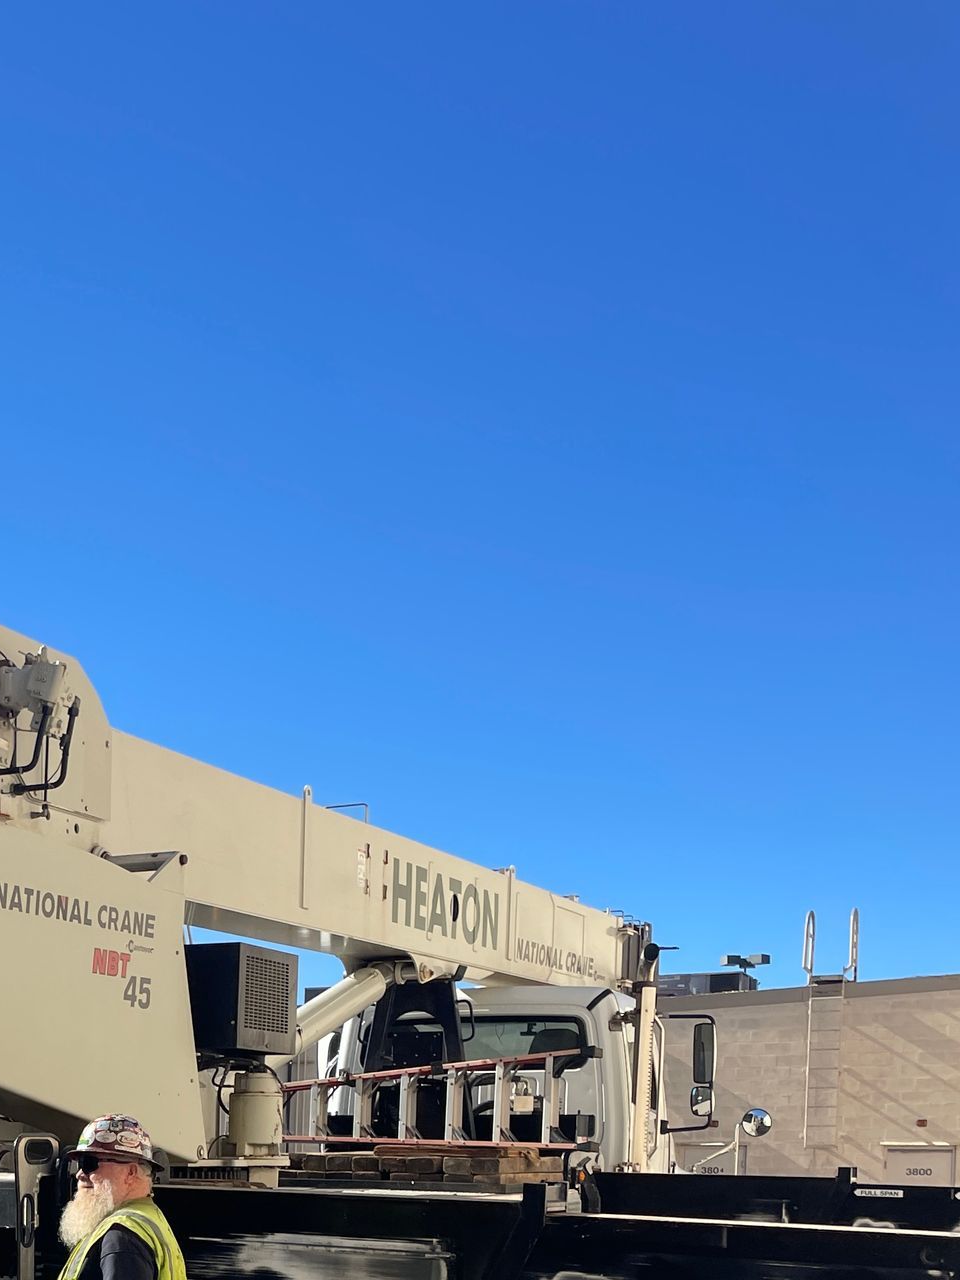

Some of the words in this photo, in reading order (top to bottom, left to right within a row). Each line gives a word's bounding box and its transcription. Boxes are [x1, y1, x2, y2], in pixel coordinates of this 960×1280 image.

[391, 857, 500, 951] HEATON
[97, 904, 156, 939] CRANE
[92, 947, 131, 979] NBT
[516, 937, 563, 971] NATIONAL
[565, 951, 594, 978] CRANE
[123, 976, 152, 1010] 45
[905, 1167, 933, 1176] 3800
[860, 1189, 878, 1197] FULL
